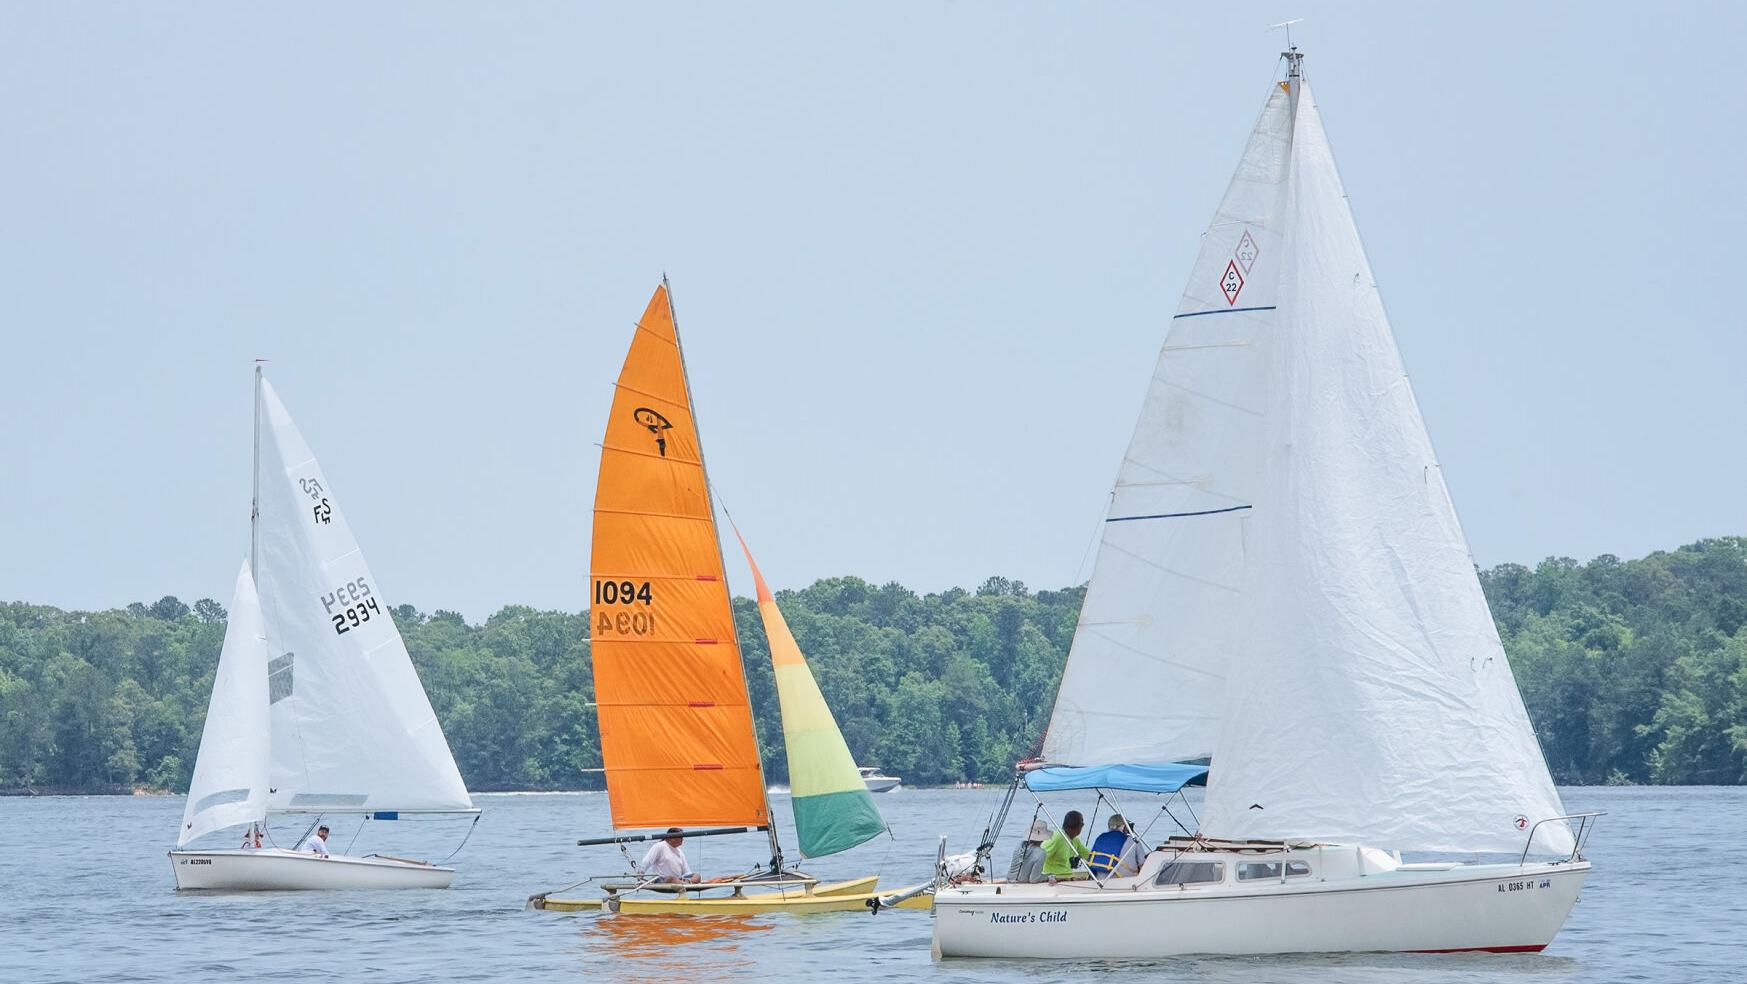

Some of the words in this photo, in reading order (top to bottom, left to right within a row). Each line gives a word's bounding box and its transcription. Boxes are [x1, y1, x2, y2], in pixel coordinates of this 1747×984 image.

[1228, 271, 1235, 280] C
[1226, 283, 1237, 292] 22
[595, 580, 653, 606] 1094
[331, 596, 381, 635] 2934
[1498, 883, 1505, 893] AL
[1508, 881, 1524, 892] 0365
[1526, 880, 1534, 889] HT
[990, 912, 1036, 923] Nature's
[1039, 911, 1068, 923] Child
